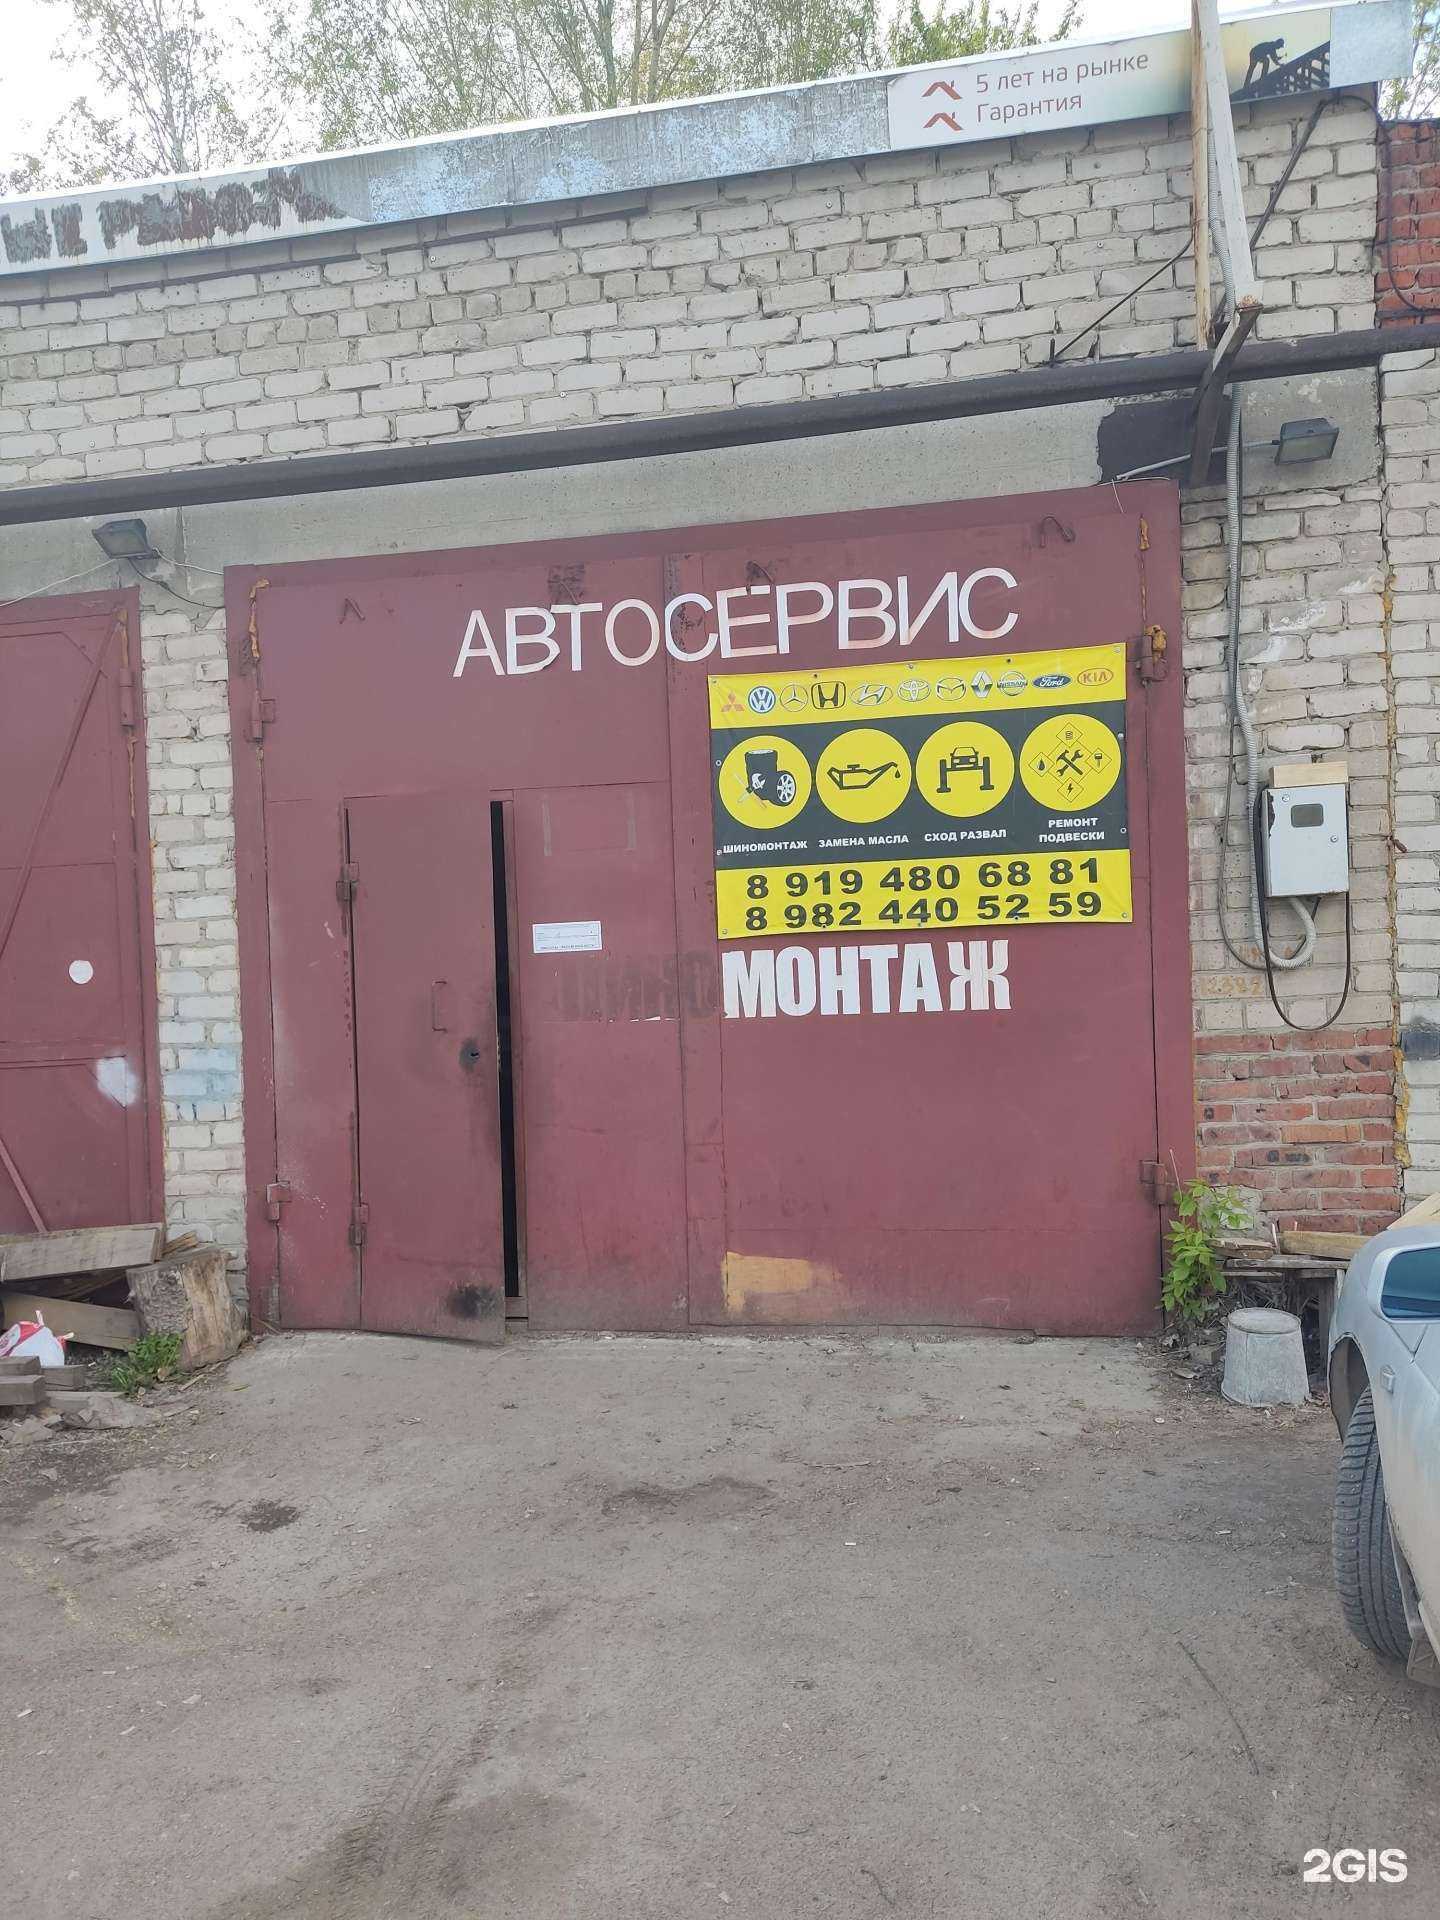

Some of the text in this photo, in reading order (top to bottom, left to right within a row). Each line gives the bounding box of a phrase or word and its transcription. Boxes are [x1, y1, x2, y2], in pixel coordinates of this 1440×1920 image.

[976, 54, 1149, 93] 5 лет на рынке
[977, 95, 1082, 124] Гарантия
[453, 567, 1018, 678] АВТОСЕРВИС
[1039, 674, 1064, 688] Ford
[1082, 671, 1108, 684] KIA
[1048, 817, 1098, 828] РЕМОНТ
[723, 840, 808, 854] ШИНОМОНТАЖ
[818, 834, 910, 848] ЗАМЕНА МАСЛА
[924, 829, 1007, 843] СХОД РАЗВАЛ
[1039, 831, 1105, 843] ПОДВЕСКИ
[746, 857, 1099, 899] 8 919 480 68 81
[745, 891, 1102, 931] 8 982 440 52 59
[721, 940, 1012, 1019] МОНТАЖ
